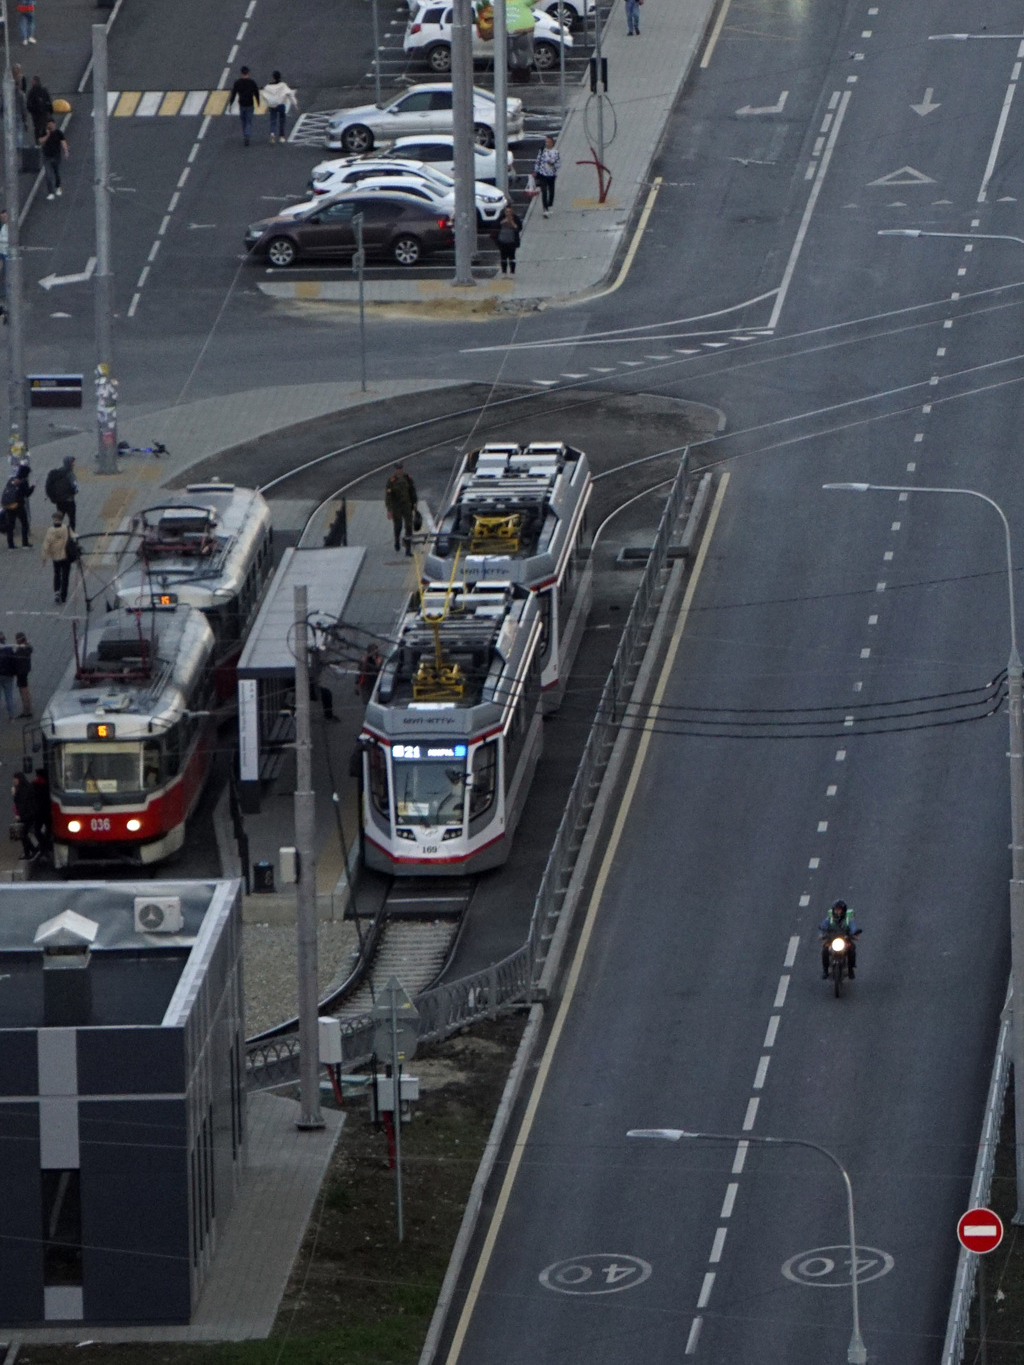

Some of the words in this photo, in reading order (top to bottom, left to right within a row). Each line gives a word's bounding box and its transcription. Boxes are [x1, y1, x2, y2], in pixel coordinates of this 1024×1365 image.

[161, 595, 170, 605] 15
[97, 725, 107, 737] 15
[90, 818, 111, 831] 036
[422, 846, 437, 854] 169
[556, 1263, 638, 1284] 40
